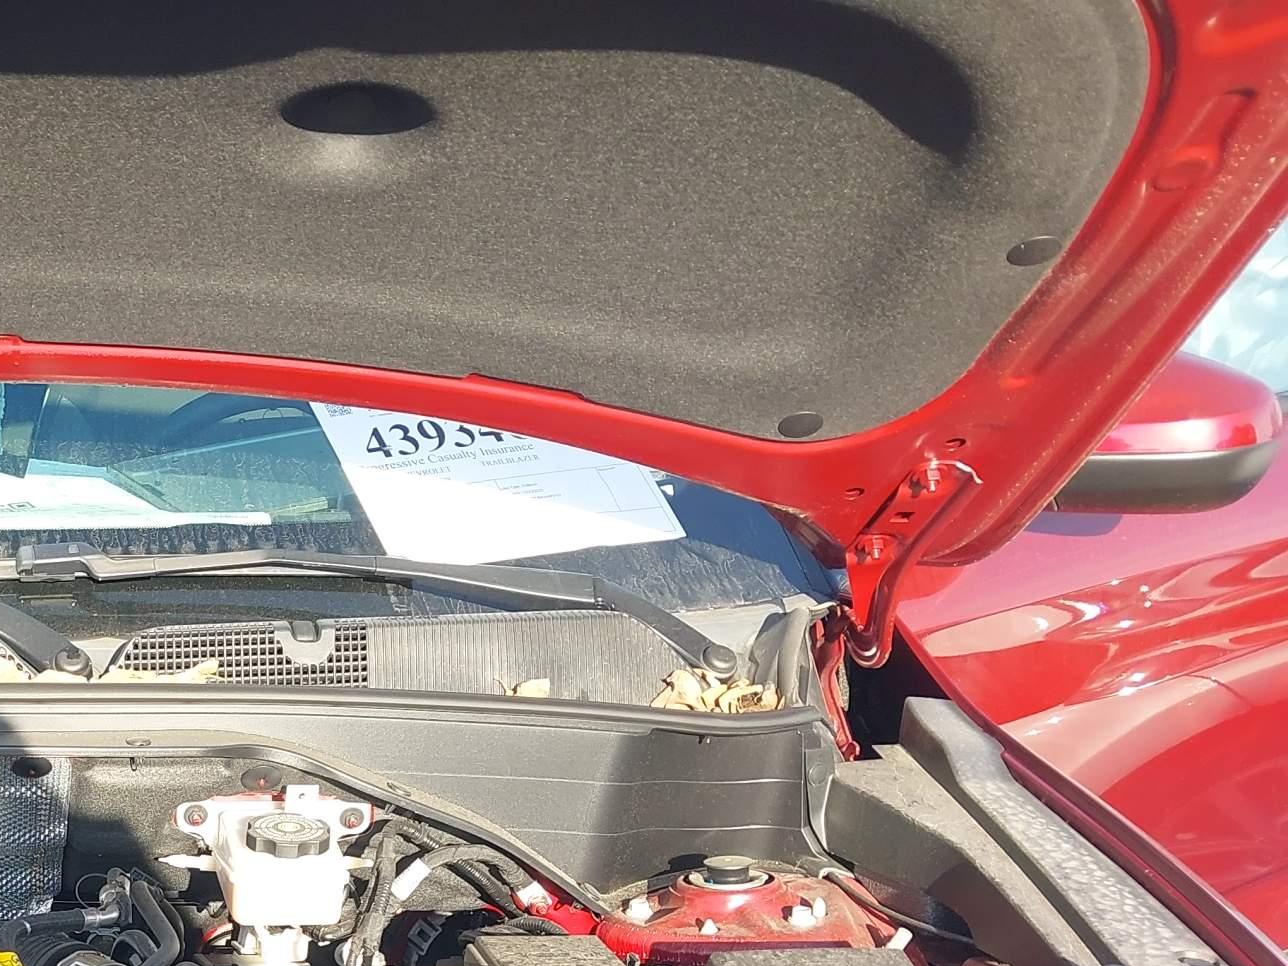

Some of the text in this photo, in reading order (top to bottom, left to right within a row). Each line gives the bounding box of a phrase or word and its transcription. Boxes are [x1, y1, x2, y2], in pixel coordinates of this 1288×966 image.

[366, 419, 528, 458] 4393
[427, 449, 477, 465] Casualty
[480, 442, 535, 457] Insurance
[480, 454, 541, 467] TRAILBLAZER
